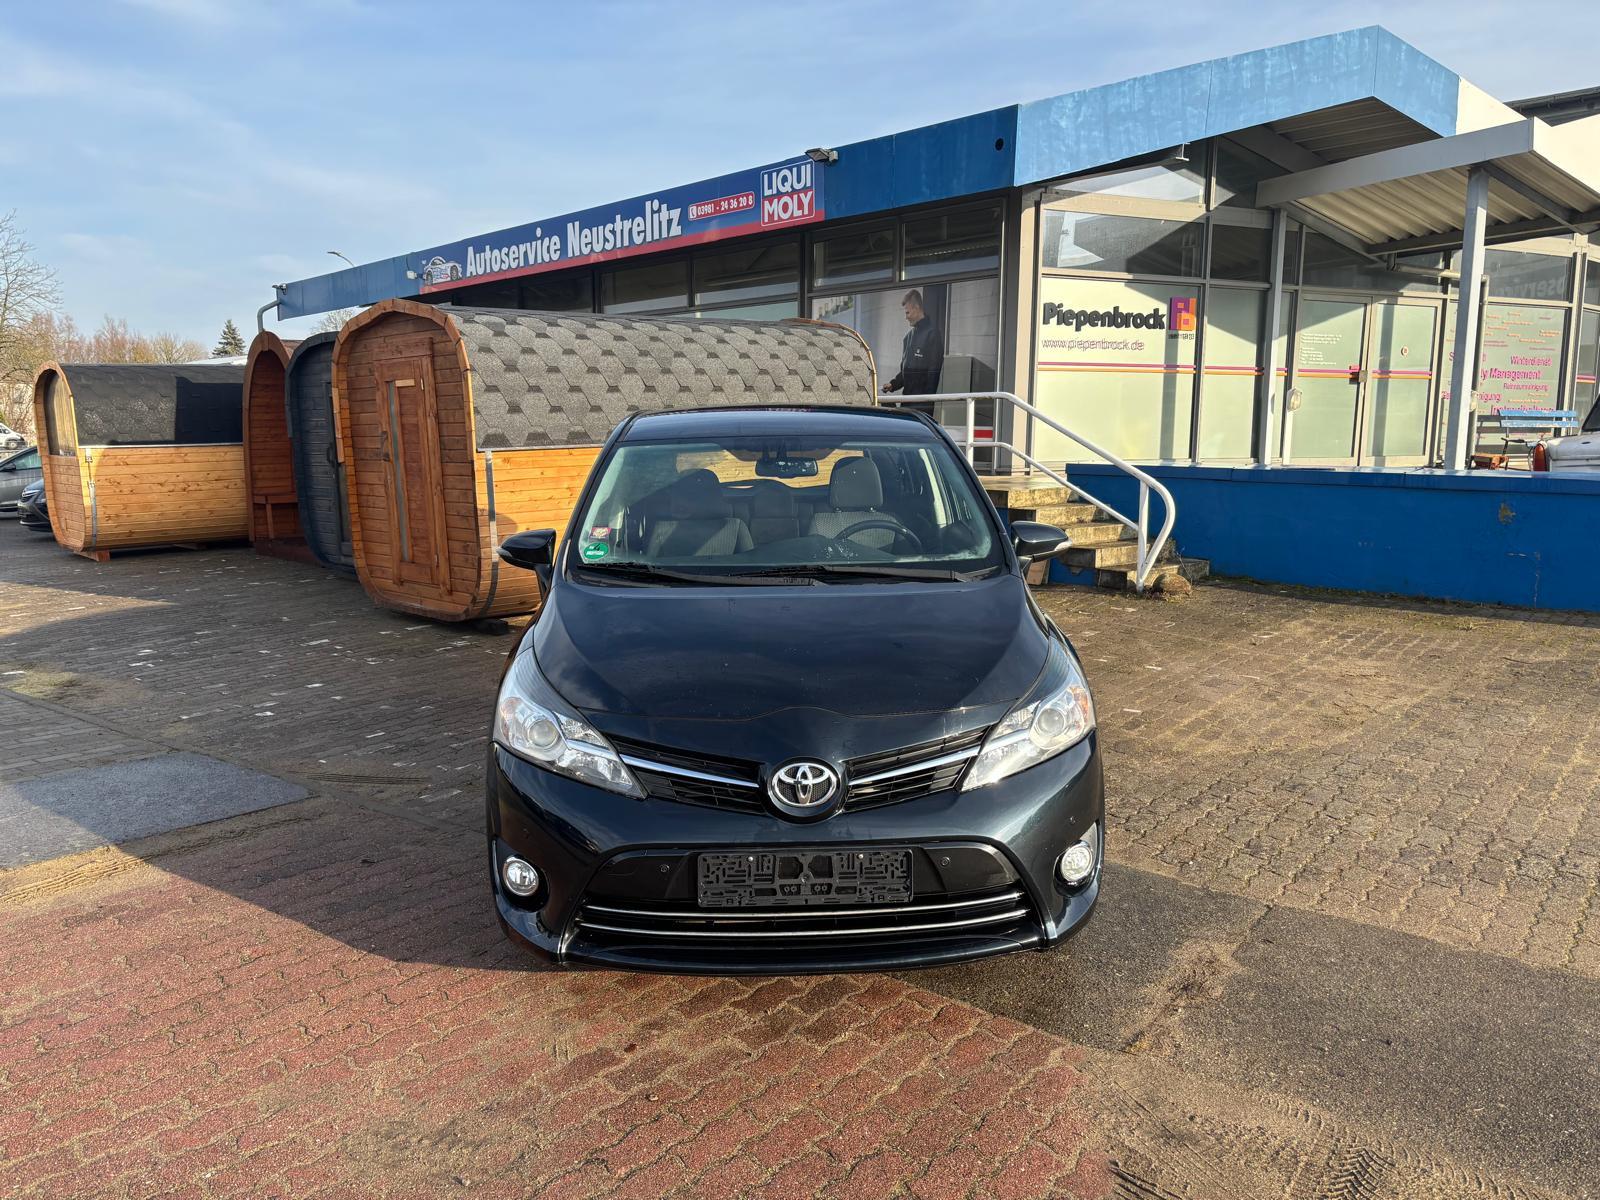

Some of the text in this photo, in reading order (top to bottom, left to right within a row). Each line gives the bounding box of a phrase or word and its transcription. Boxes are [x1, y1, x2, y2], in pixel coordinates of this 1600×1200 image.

[763, 163, 811, 196] LIQUI
[697, 203, 714, 216] 03981
[720, 200, 728, 211] 24
[730, 198, 737, 209] 36
[739, 196, 747, 207] 20
[748, 195, 753, 205] 8
[764, 191, 813, 223] MOLY
[466, 199, 682, 277] Autoservice Neustrelitz
[1042, 302, 1166, 332] Piepenbrock
[1041, 338, 1145, 352] www.piepenbrock.de
[1490, 367, 1542, 381] Management
